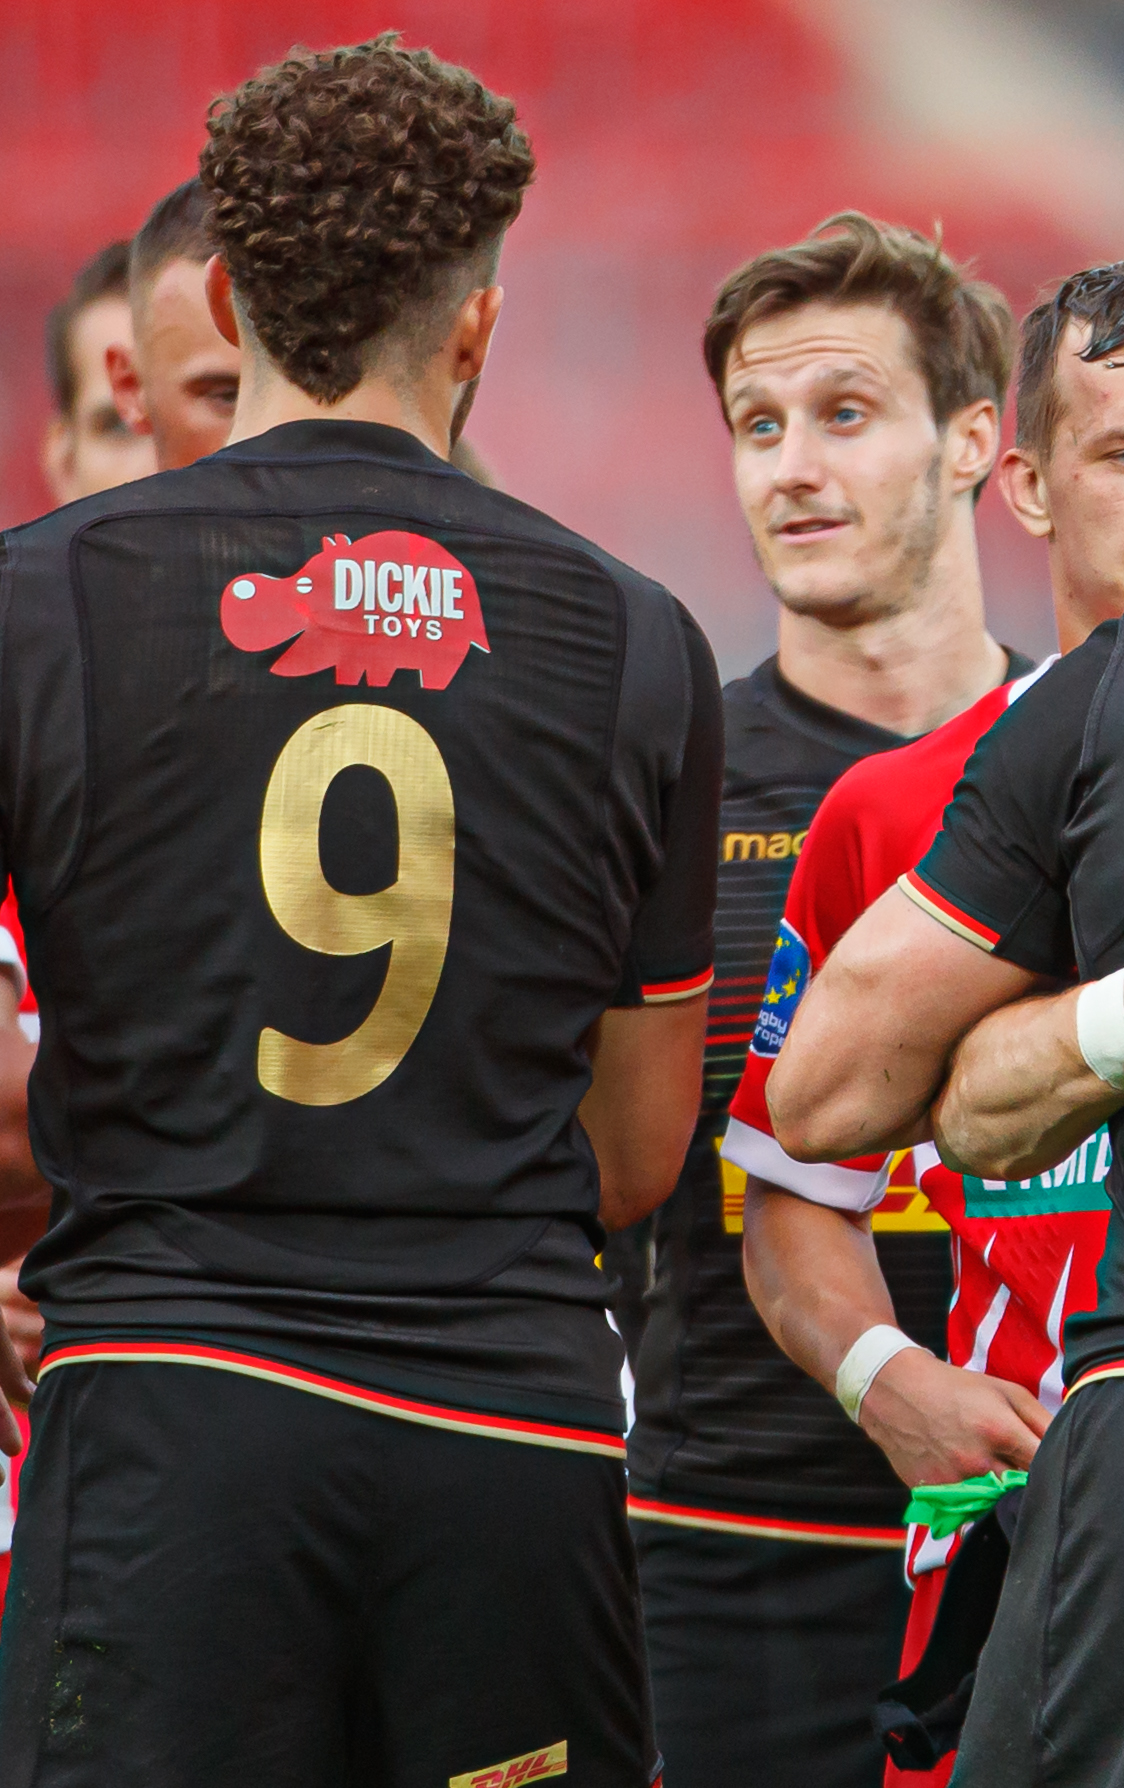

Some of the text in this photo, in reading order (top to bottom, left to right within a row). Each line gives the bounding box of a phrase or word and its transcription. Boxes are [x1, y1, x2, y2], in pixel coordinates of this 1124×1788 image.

[334, 559, 464, 619] DICKIE
[363, 614, 443, 641] TOYS
[258, 703, 455, 1106] 9
[470, 1752, 553, 1788] DHL
